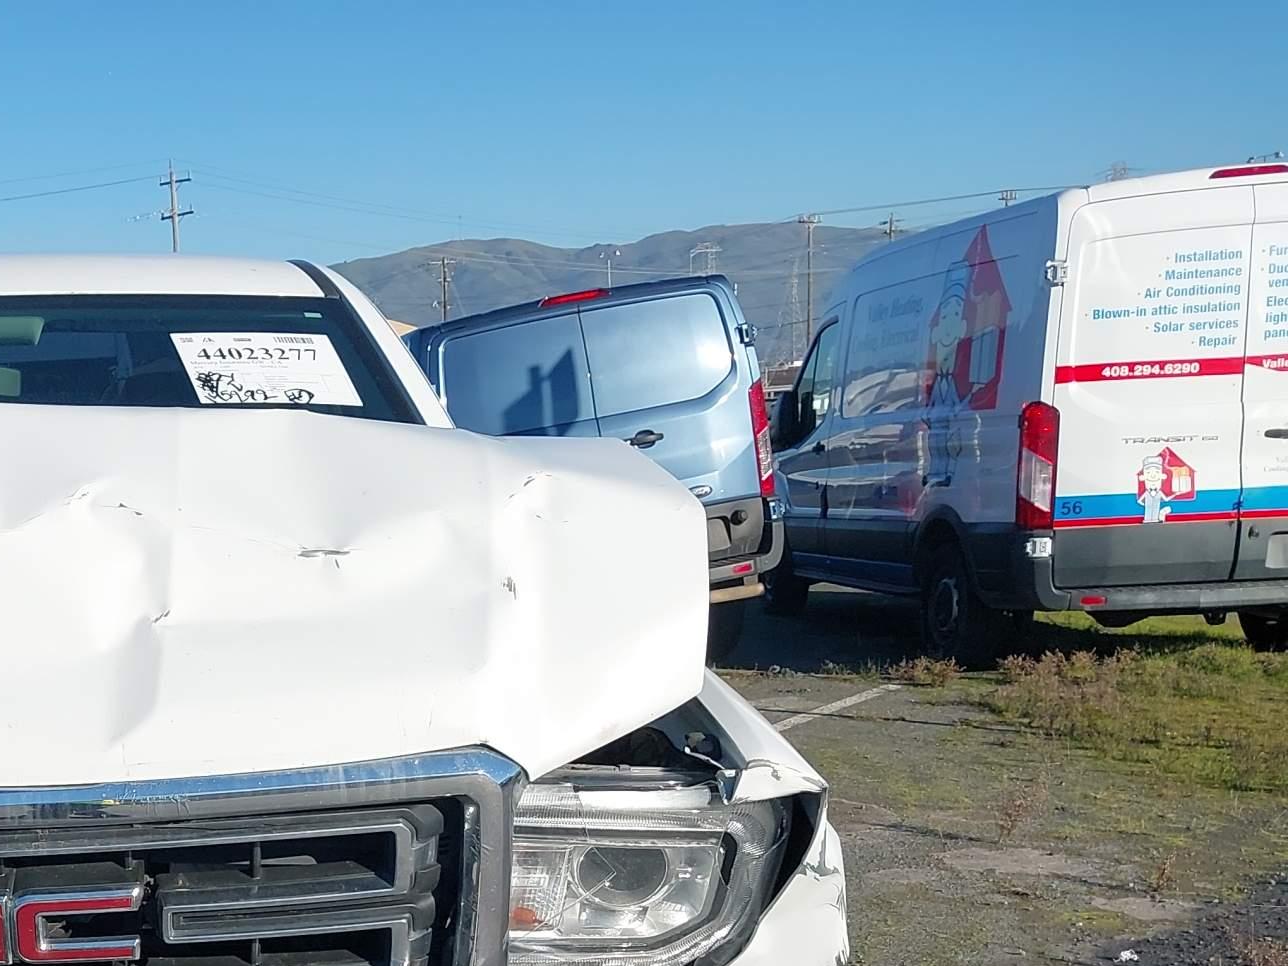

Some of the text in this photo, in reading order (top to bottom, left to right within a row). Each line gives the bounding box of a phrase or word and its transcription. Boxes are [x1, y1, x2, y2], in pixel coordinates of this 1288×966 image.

[1174, 249, 1242, 263] Installation
[1164, 266, 1242, 281] Maintenance
[1144, 283, 1241, 300] Air Conditioning
[1092, 299, 1241, 320] Blown-in attic insulation
[1153, 317, 1239, 334] Solar services
[1198, 334, 1237, 348] Repair
[197, 347, 316, 361] 44023277
[1101, 362, 1201, 377] 408.294.6290
[1121, 435, 1199, 445] TRANSIT
[1061, 501, 1083, 516] 56
